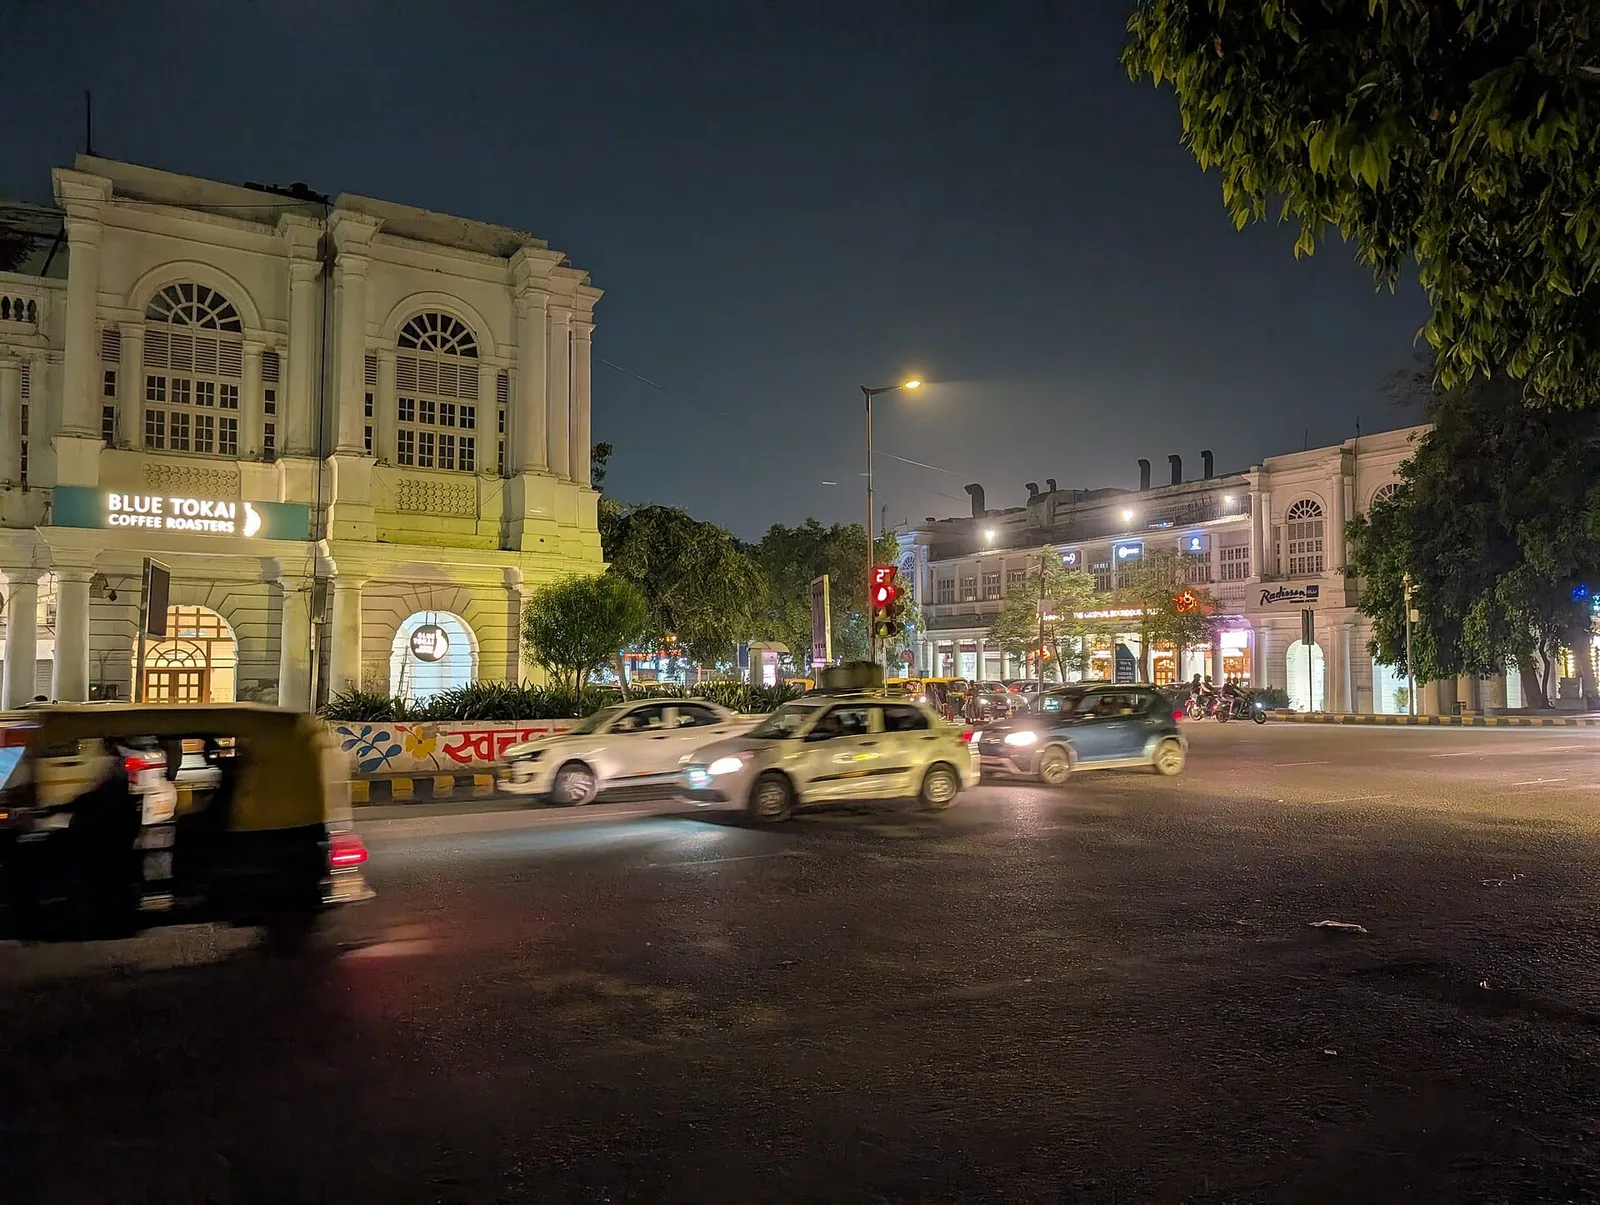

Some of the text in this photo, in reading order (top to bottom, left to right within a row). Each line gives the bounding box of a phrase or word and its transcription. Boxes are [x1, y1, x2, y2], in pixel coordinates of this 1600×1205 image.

[108, 493, 236, 519] BLUE TOKAI
[108, 513, 235, 533] COFFEE ROASTERS
[1260, 586, 1306, 606] Radisson
